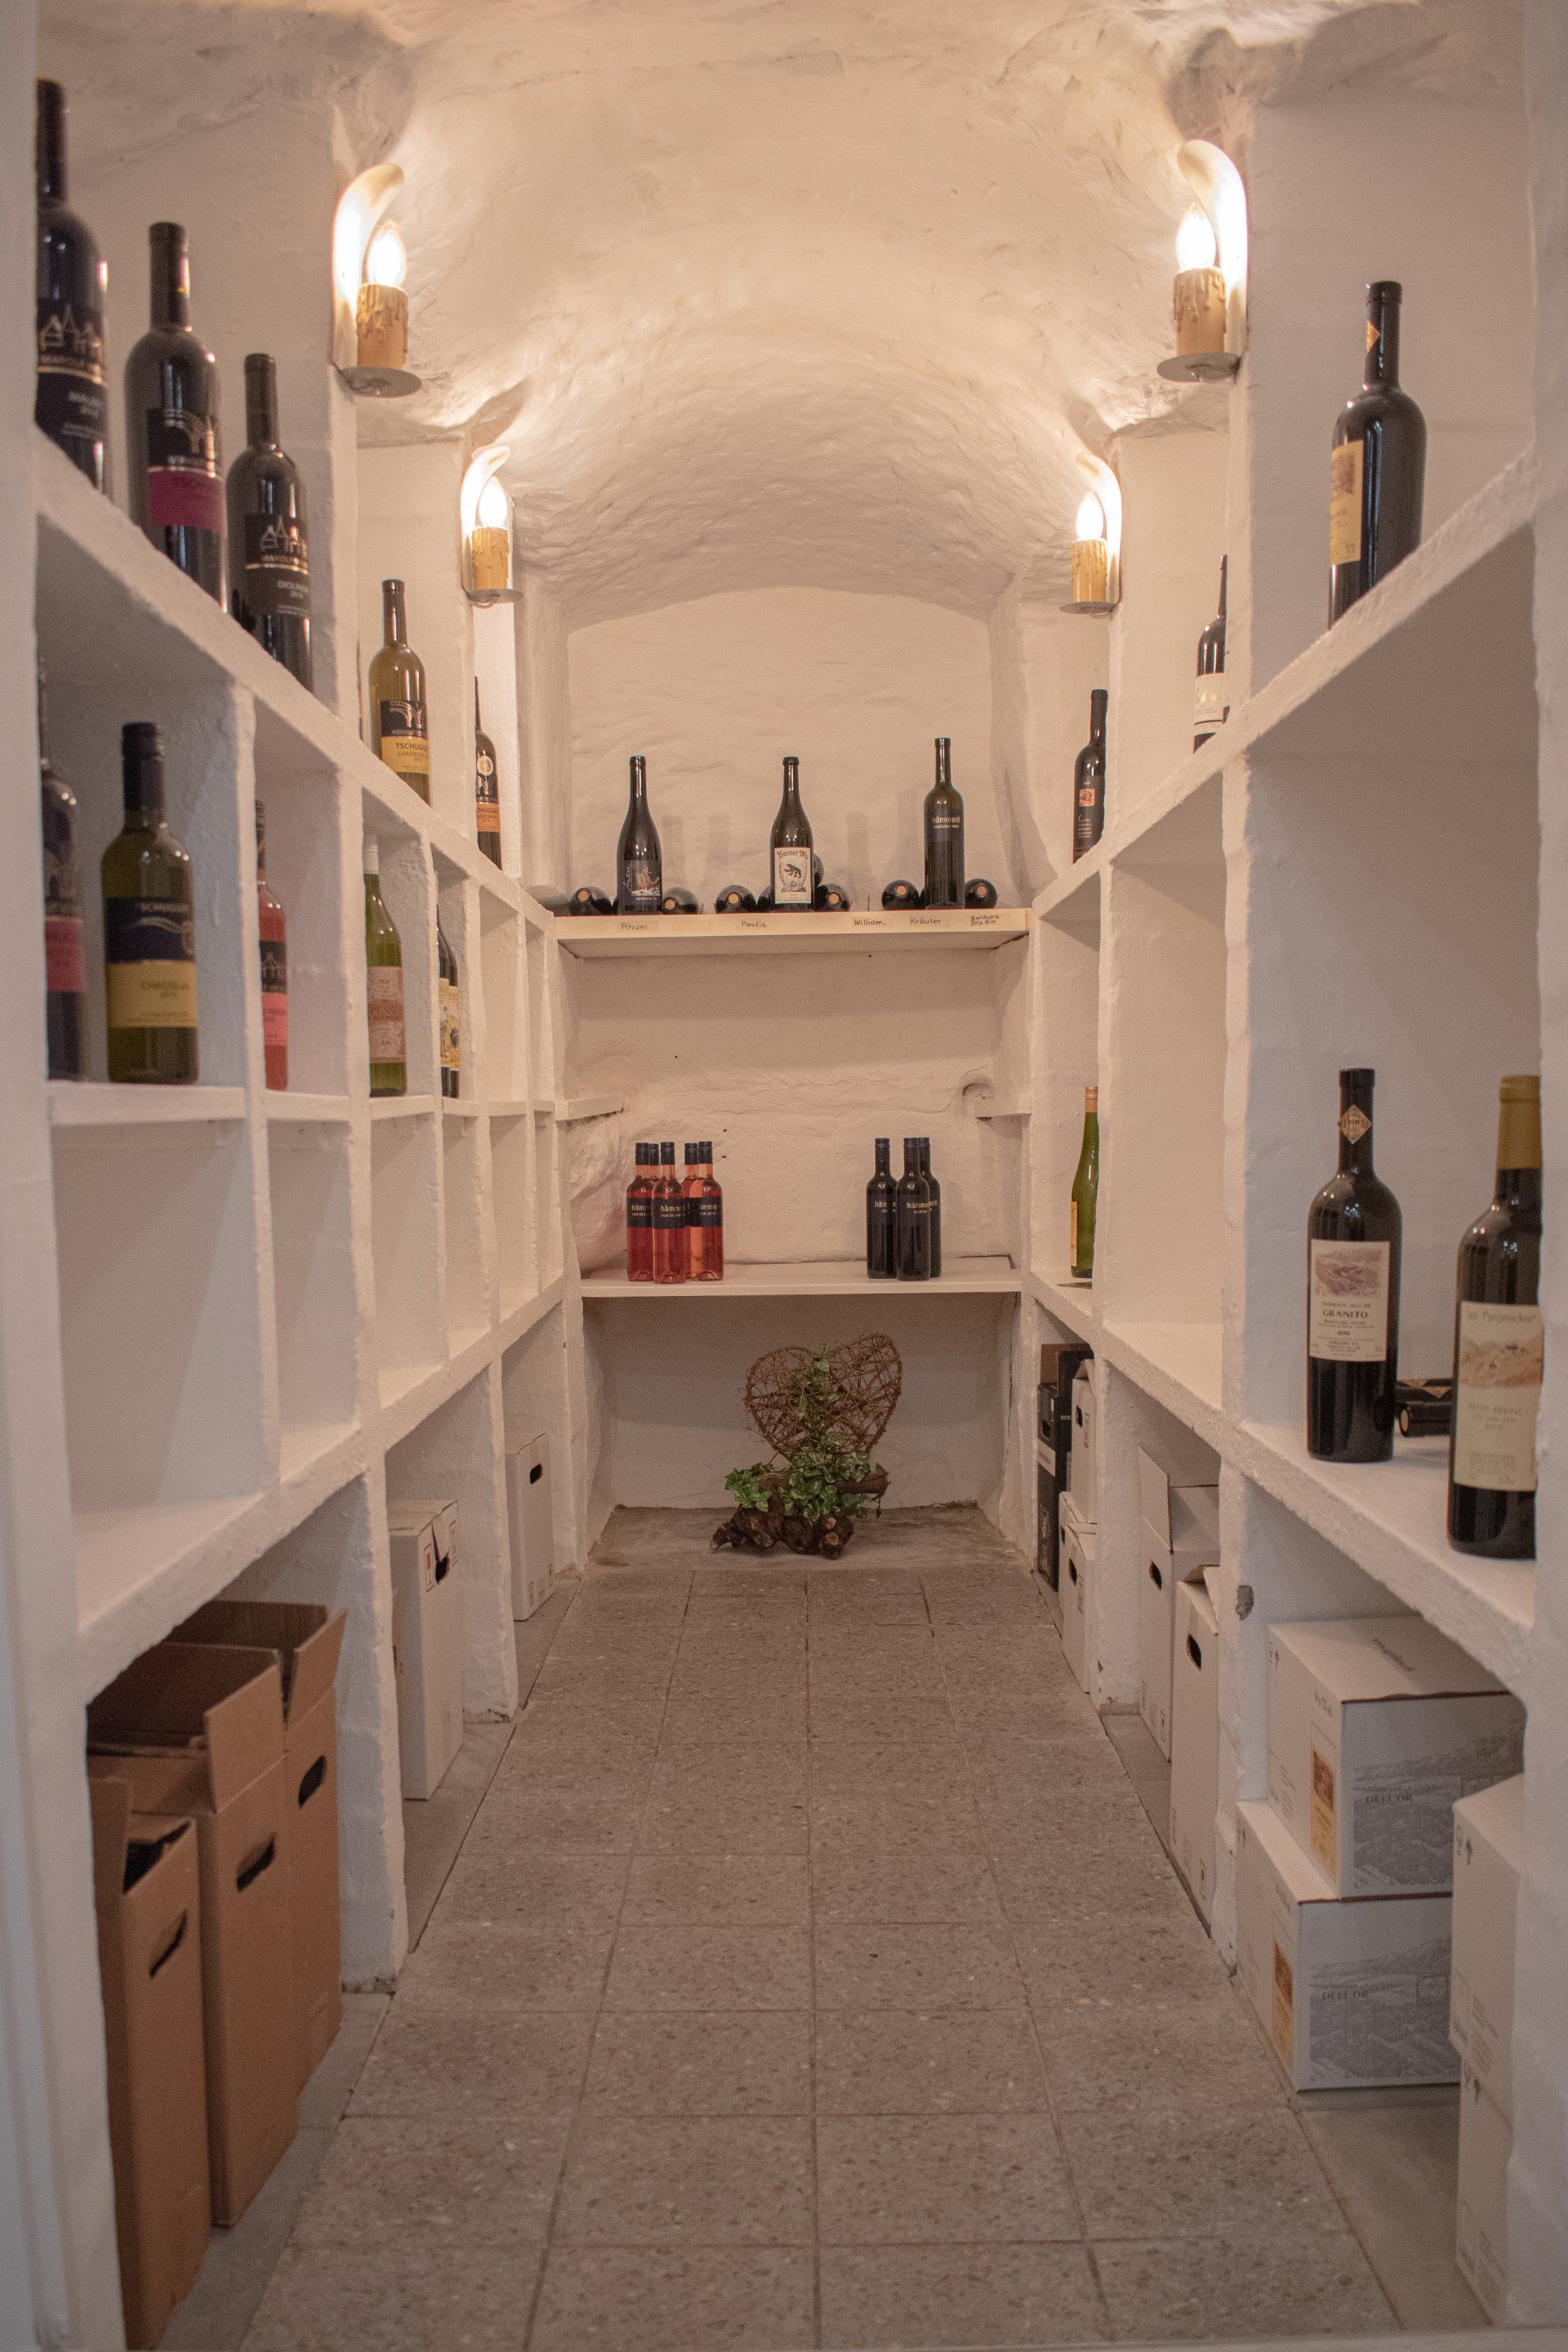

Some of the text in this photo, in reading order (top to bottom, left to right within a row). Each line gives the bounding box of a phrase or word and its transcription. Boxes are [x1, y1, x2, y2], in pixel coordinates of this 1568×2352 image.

[910, 917, 942, 925] Kräuter
[621, 922, 648, 930] Rhum
[1322, 1310, 1368, 1318] GRANITO
